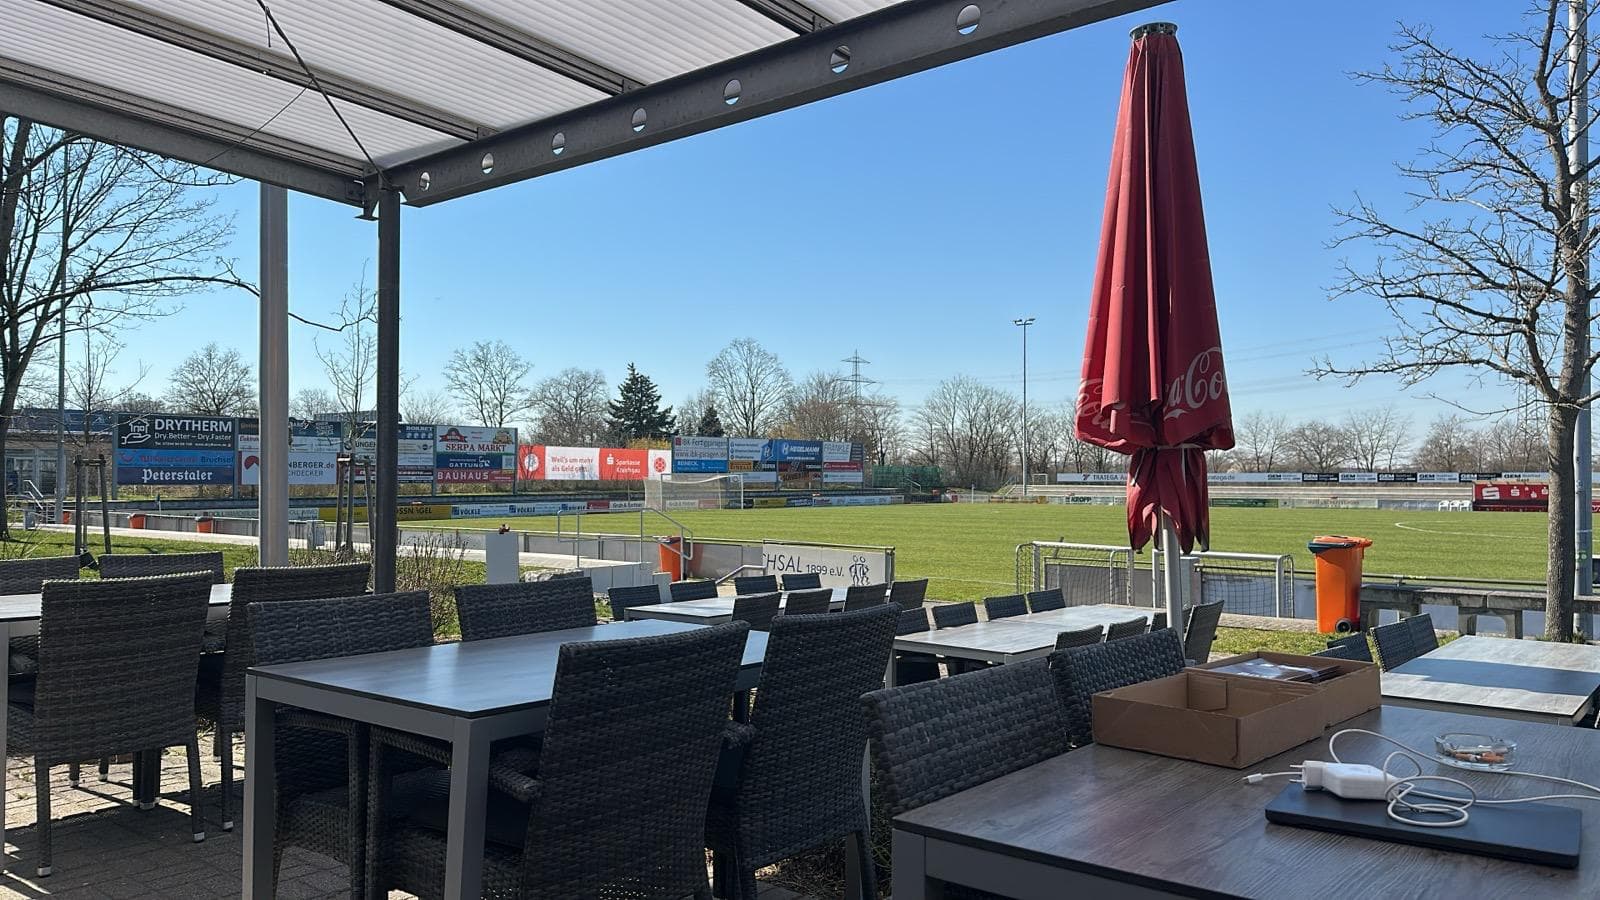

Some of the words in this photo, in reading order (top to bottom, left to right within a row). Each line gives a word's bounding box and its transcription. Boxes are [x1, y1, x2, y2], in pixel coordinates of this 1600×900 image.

[154, 418, 232, 433] DRYTHERM
[445, 443, 475, 452] SERPA
[477, 444, 507, 452] MARKT
[141, 468, 213, 484] Peterstaler
[437, 471, 489, 480] BAUHAUS
[805, 563, 828, 576] 1899
[829, 566, 845, 577] e.V.
